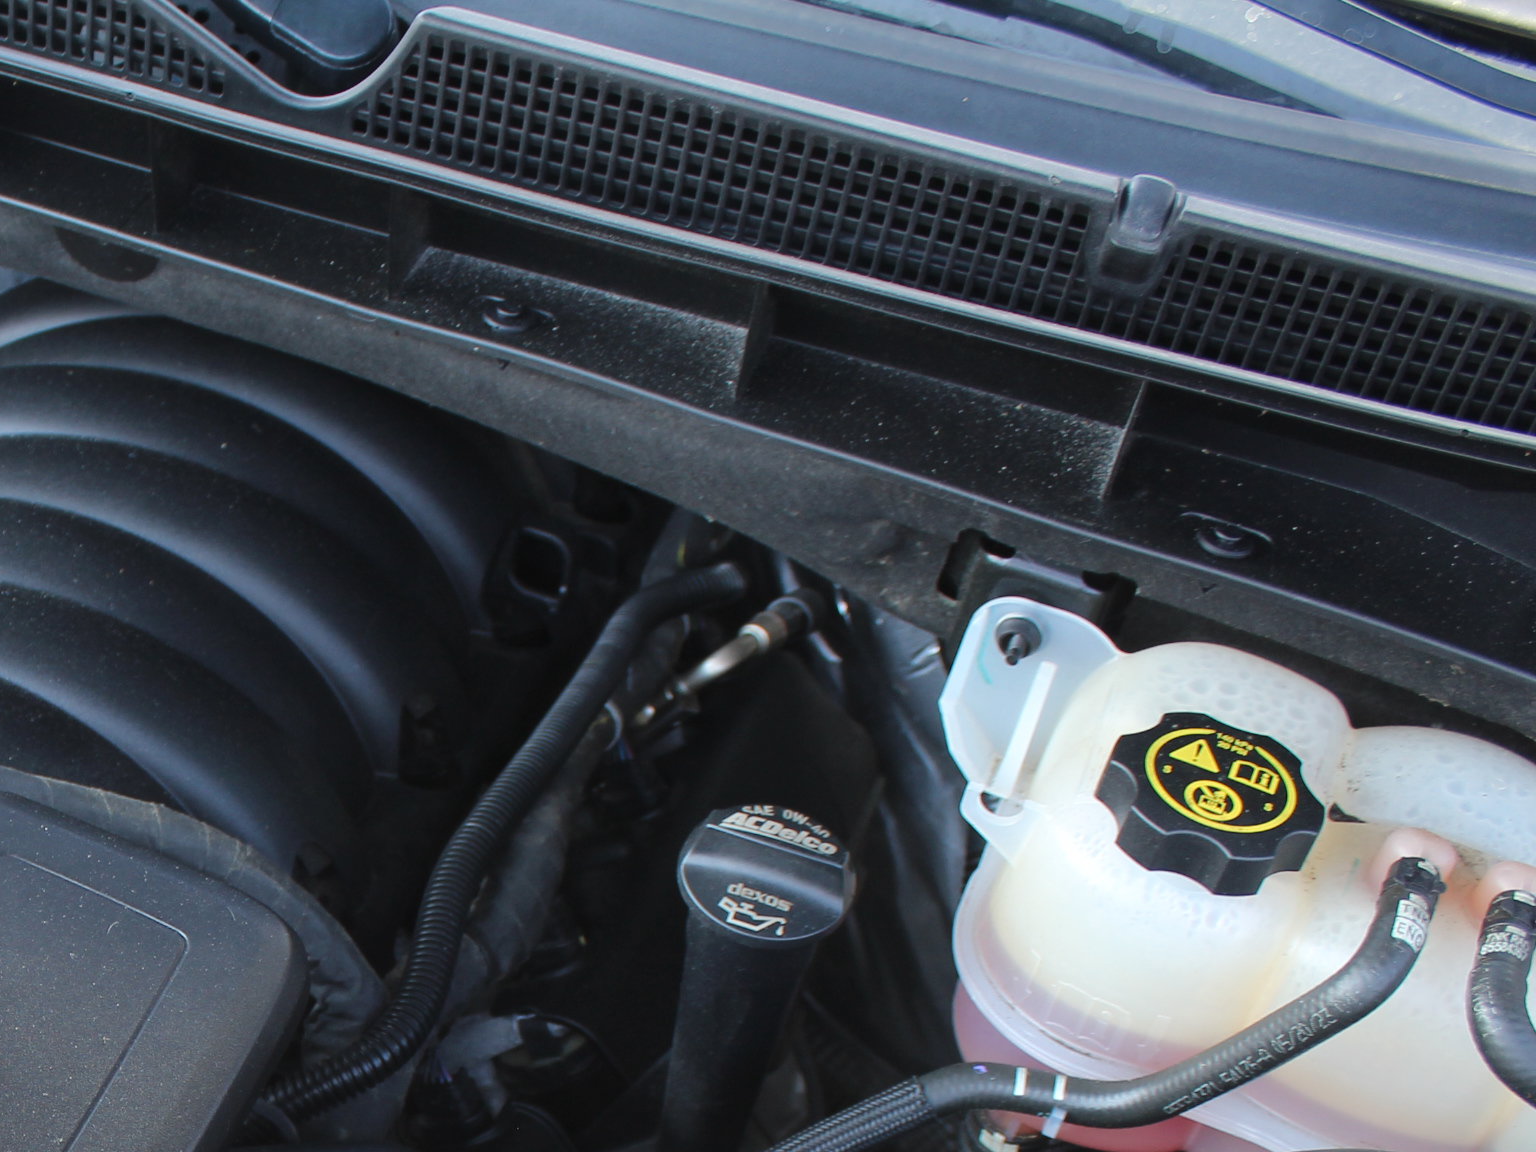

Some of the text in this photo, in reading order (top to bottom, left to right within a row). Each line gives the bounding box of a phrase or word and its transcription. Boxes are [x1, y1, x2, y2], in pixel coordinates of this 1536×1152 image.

[721, 811, 838, 855] ACDelco
[742, 805, 831, 839] SAE 0W-40
[727, 883, 794, 912] dexos
